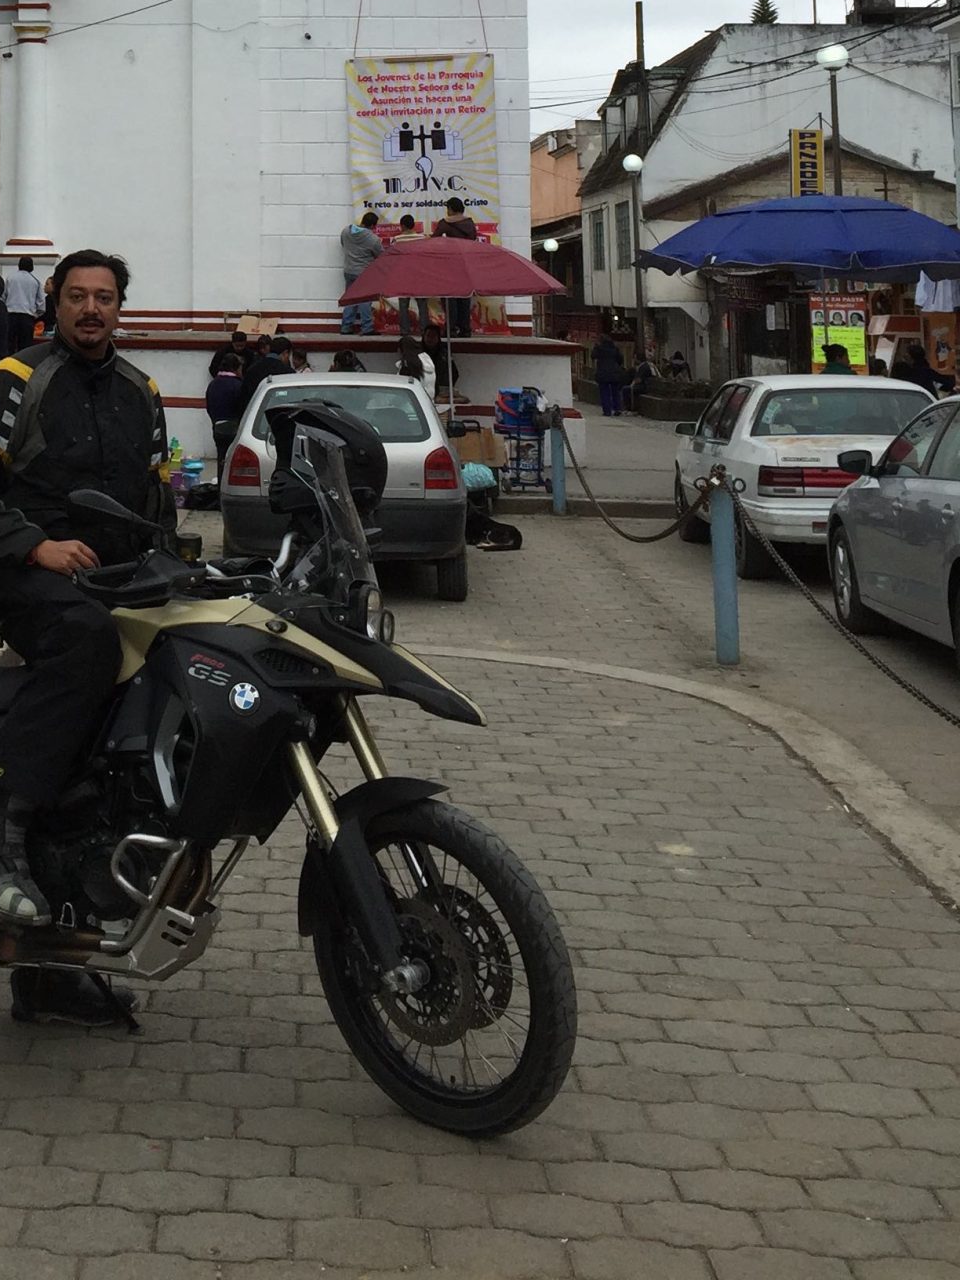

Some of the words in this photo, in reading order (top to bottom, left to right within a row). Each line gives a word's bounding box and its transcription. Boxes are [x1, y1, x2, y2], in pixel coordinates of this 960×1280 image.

[375, 73, 411, 82] Jovenes
[413, 72, 425, 80] de
[428, 72, 436, 80] la
[439, 71, 484, 80] Parroquia
[367, 86, 378, 94] de
[381, 84, 416, 93] Nuestra
[466, 82, 475, 90] la
[426, 95, 452, 103] hacen
[356, 108, 388, 117] cordial
[458, 105, 486, 114] Retiro
[363, 200, 372, 208] Te
[464, 198, 488, 206] Cristo
[188, 663, 232, 686] GS
